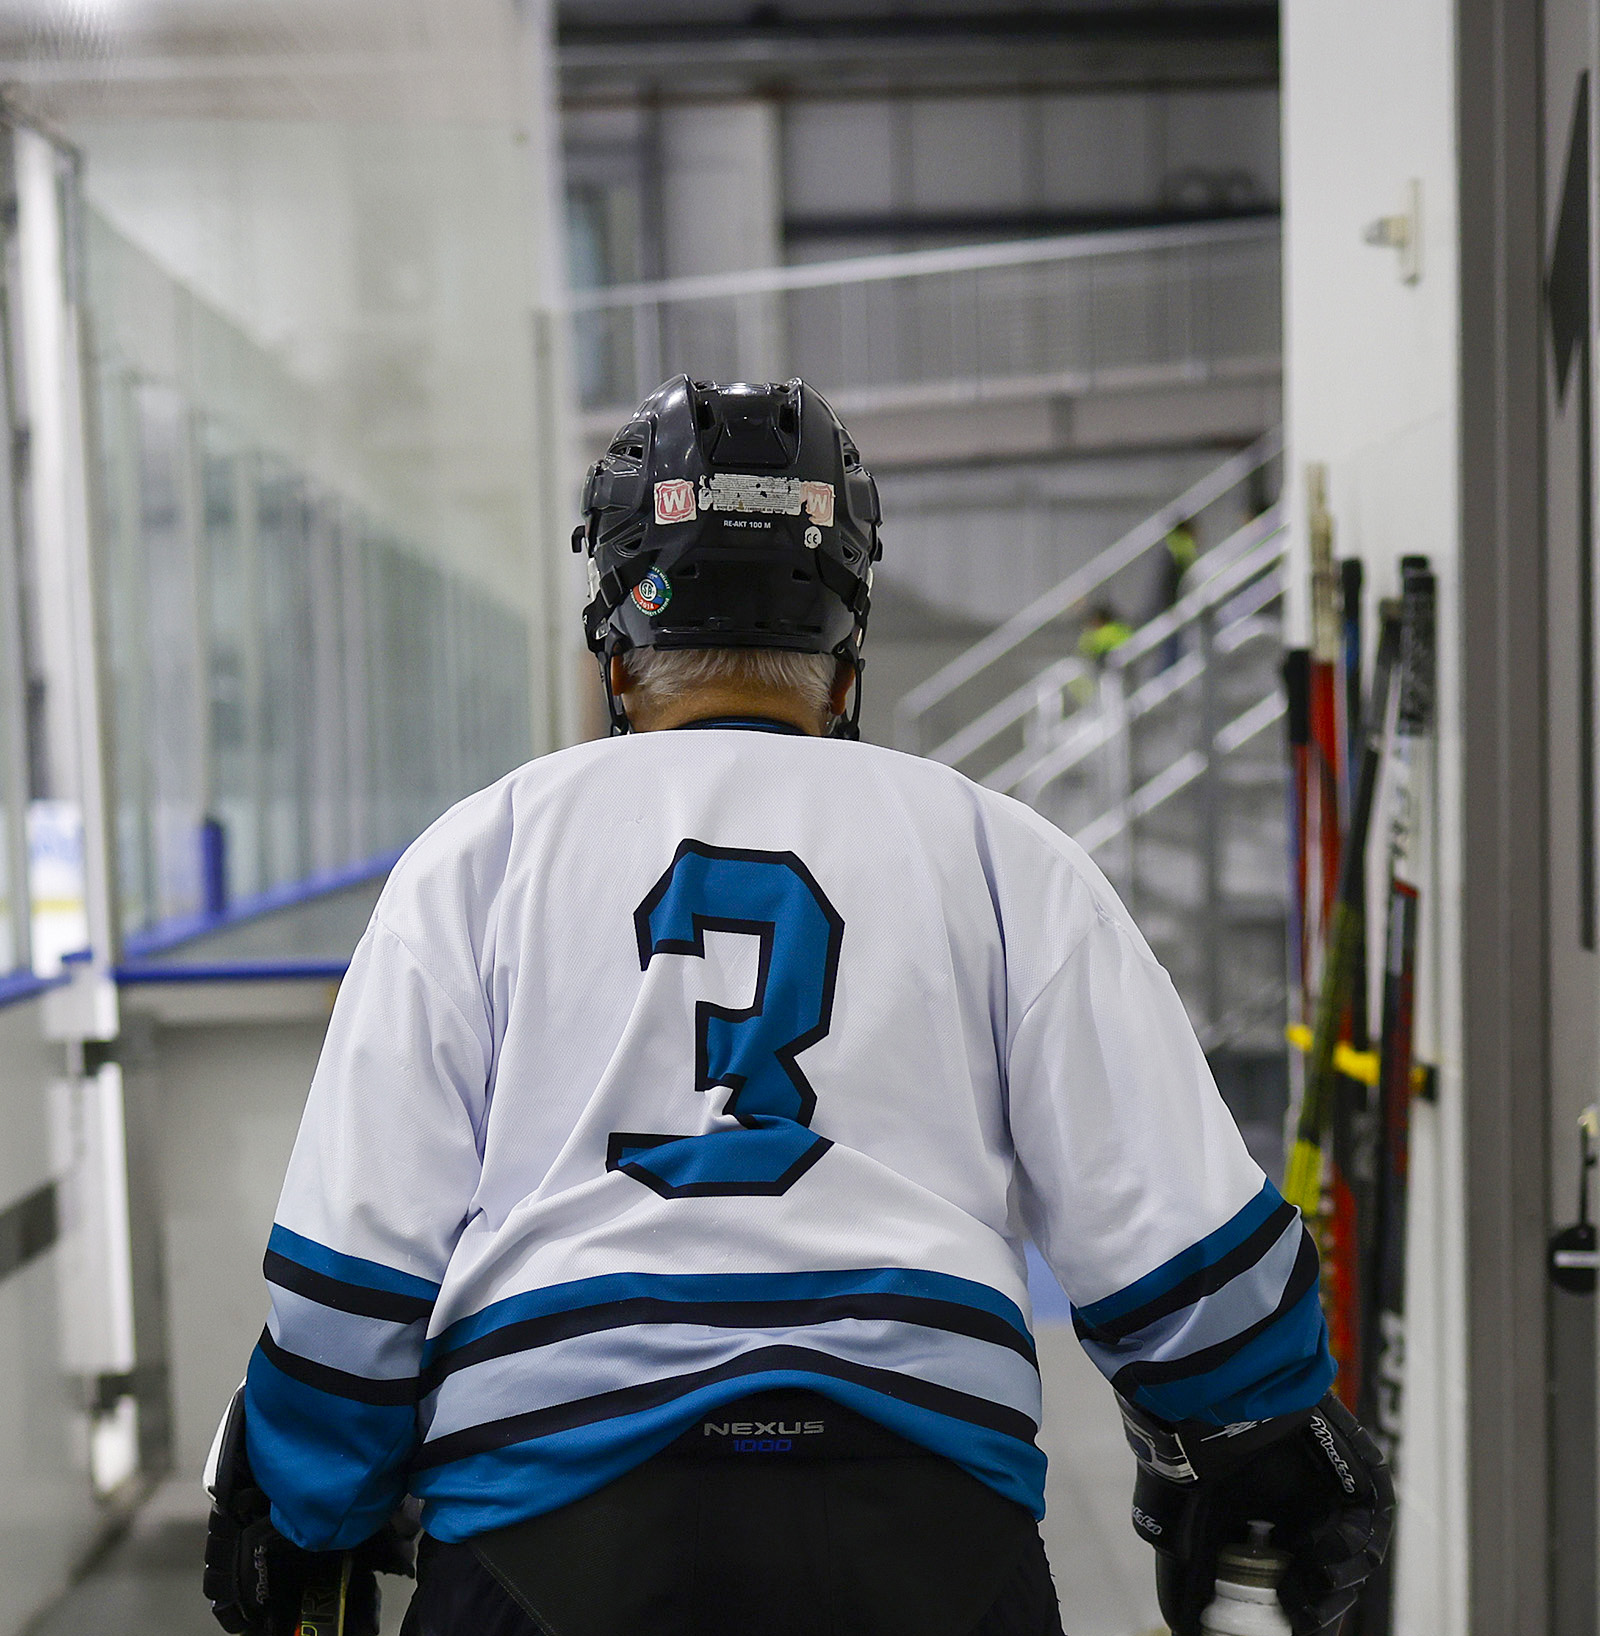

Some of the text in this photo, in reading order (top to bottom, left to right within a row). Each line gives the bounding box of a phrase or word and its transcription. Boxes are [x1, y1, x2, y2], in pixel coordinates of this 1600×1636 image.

[723, 519, 772, 530] RE-AKT 100 M
[605, 838, 845, 1200] 3
[703, 1420, 825, 1437] NEXUS
[732, 1438, 793, 1454] 1000
